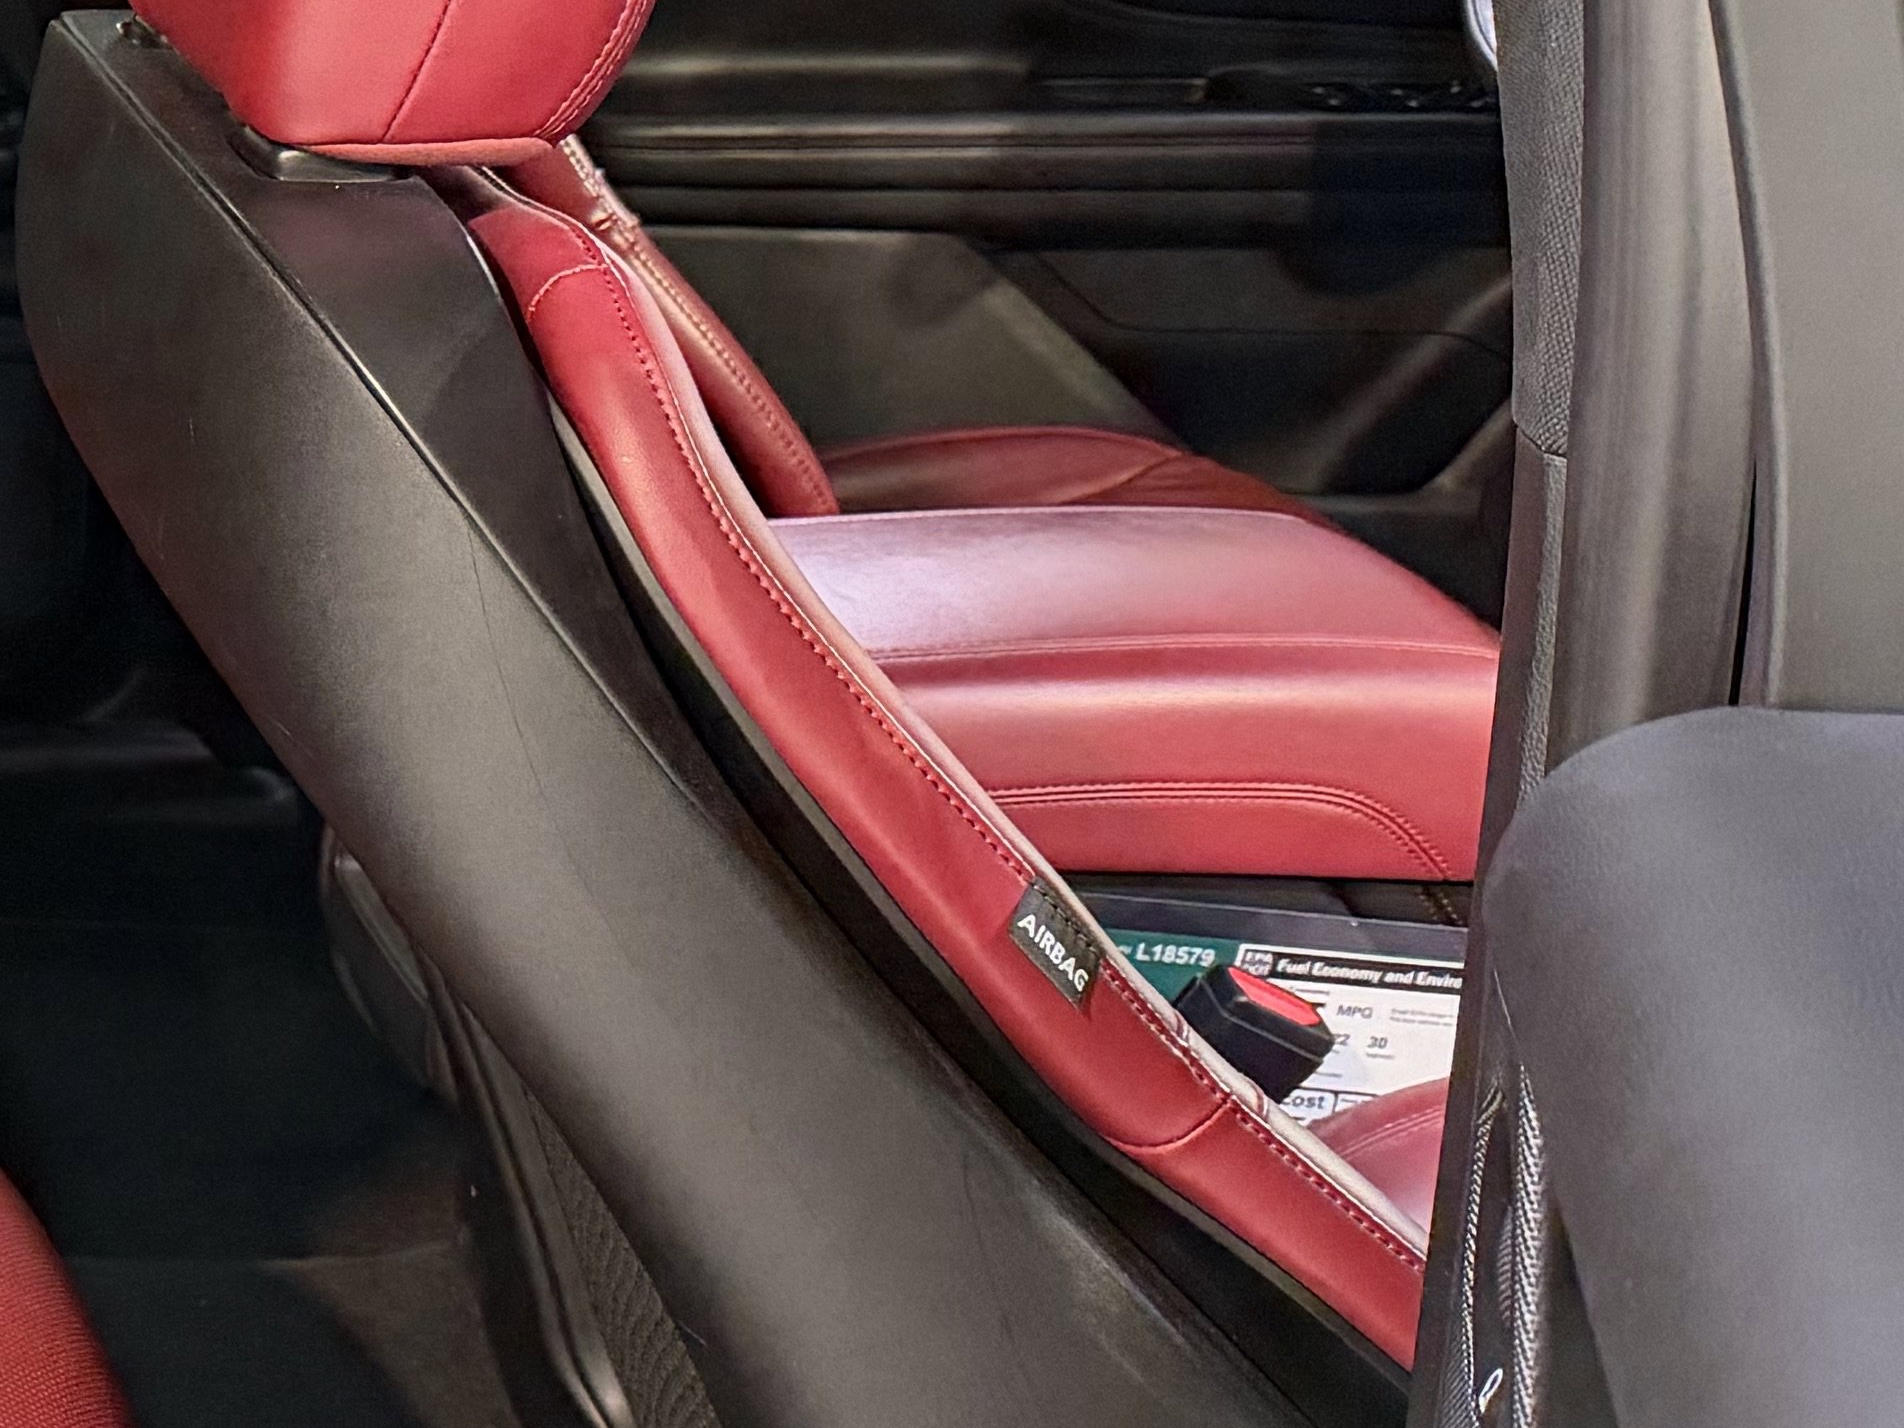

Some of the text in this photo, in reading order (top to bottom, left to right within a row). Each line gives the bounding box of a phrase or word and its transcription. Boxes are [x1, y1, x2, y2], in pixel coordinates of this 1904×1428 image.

[1017, 914, 1089, 992] AIRBAG
[1135, 942, 1216, 967] L18579
[1277, 958, 1311, 975] Fuel
[1312, 961, 1383, 984] Economy
[1383, 971, 1415, 985] and
[1336, 1004, 1373, 1019] MPG
[1366, 1036, 1388, 1049] 30
